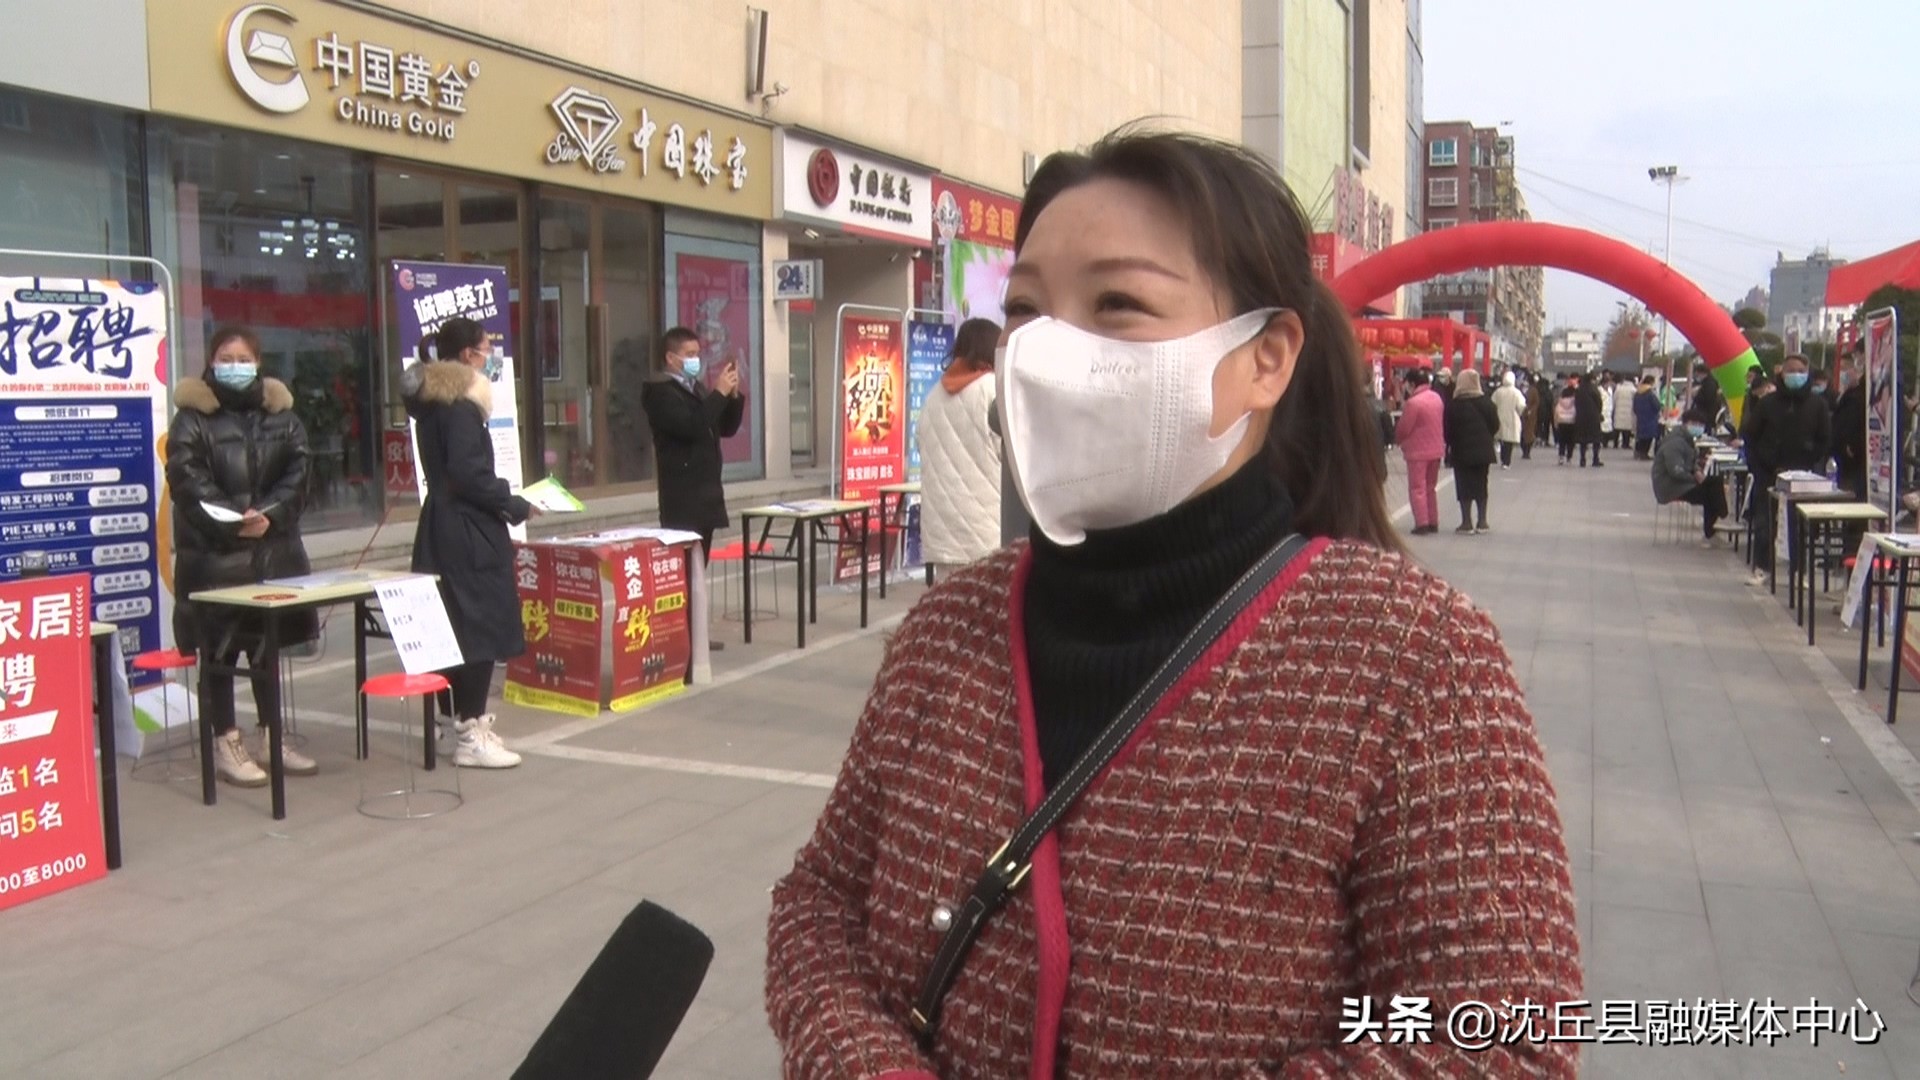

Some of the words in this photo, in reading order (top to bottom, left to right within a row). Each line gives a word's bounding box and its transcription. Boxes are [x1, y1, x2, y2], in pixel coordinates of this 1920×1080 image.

[317, 32, 468, 113] 中国黄金
[339, 97, 402, 129] China
[408, 112, 455, 139] Gold
[546, 132, 582, 163] Sino
[633, 107, 748, 189] 中国珠宝
[849, 163, 912, 206] 中国银行
[968, 199, 1015, 240] 梦金园
[413, 279, 495, 325] 诚聘英才
[0, 301, 157, 379] 招聘
[624, 556, 643, 600] 央企
